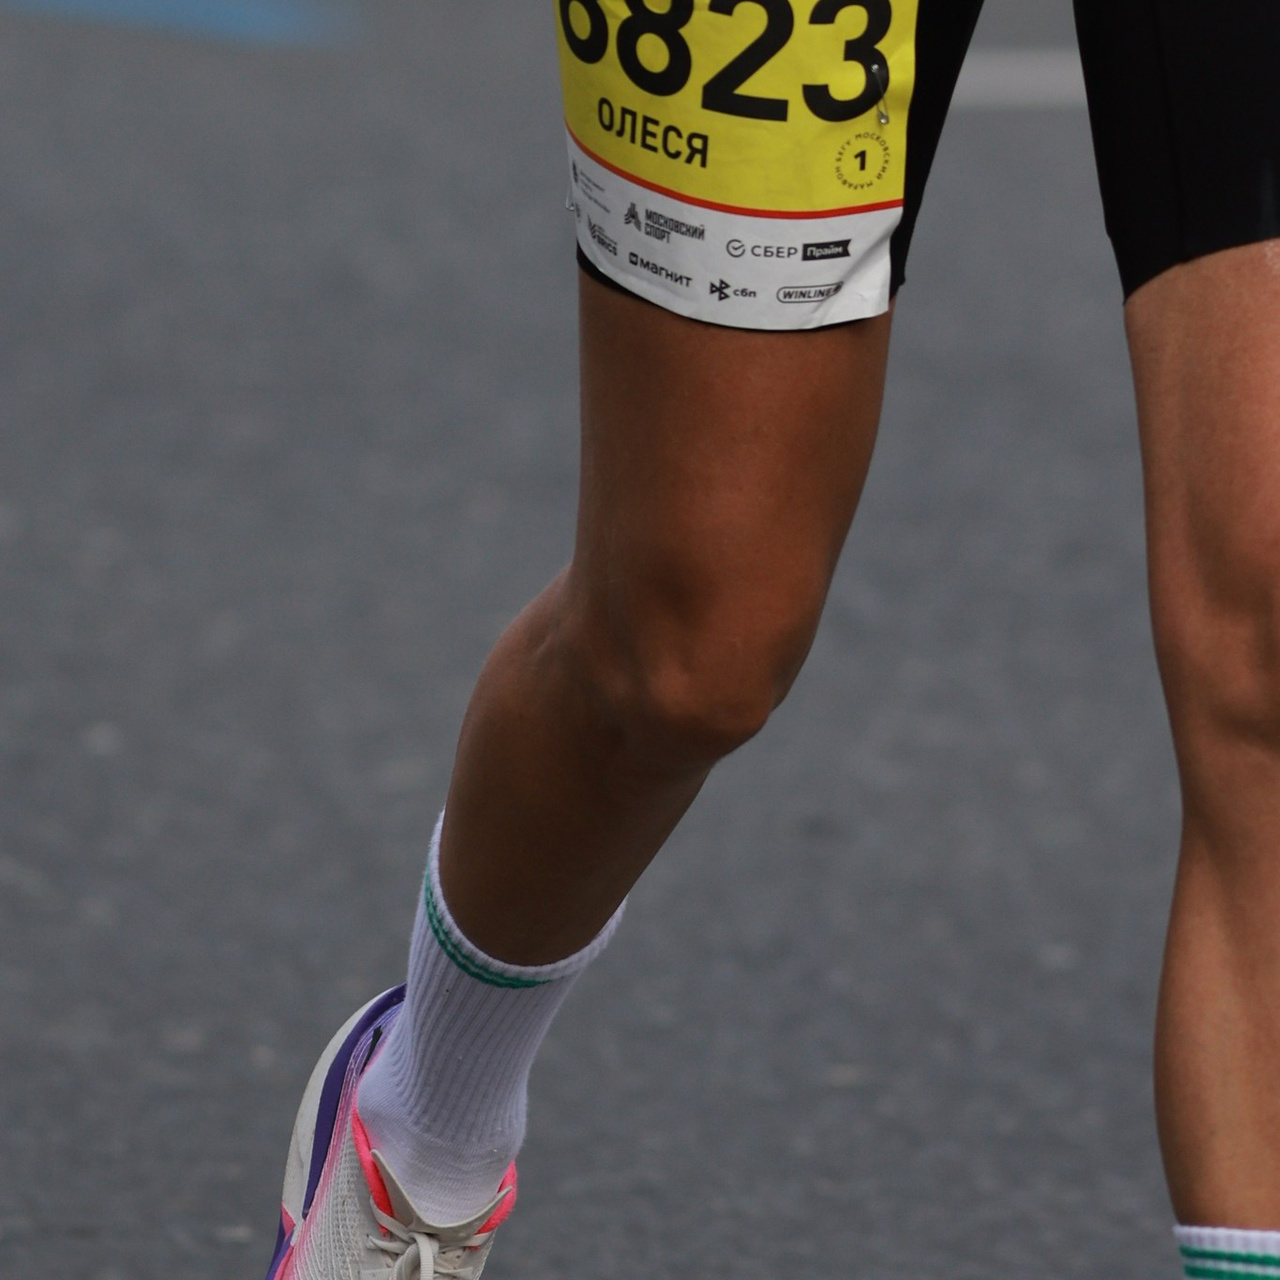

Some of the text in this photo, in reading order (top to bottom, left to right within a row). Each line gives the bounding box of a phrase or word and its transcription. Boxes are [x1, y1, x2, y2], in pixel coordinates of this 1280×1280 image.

[597, 96, 710, 169] ОЛЕСЯ
[854, 149, 867, 171] 1
[645, 208, 706, 241] МОСКОВСКИЙ
[751, 244, 844, 259] СБЕР Прайм
[733, 287, 757, 298] сбп
